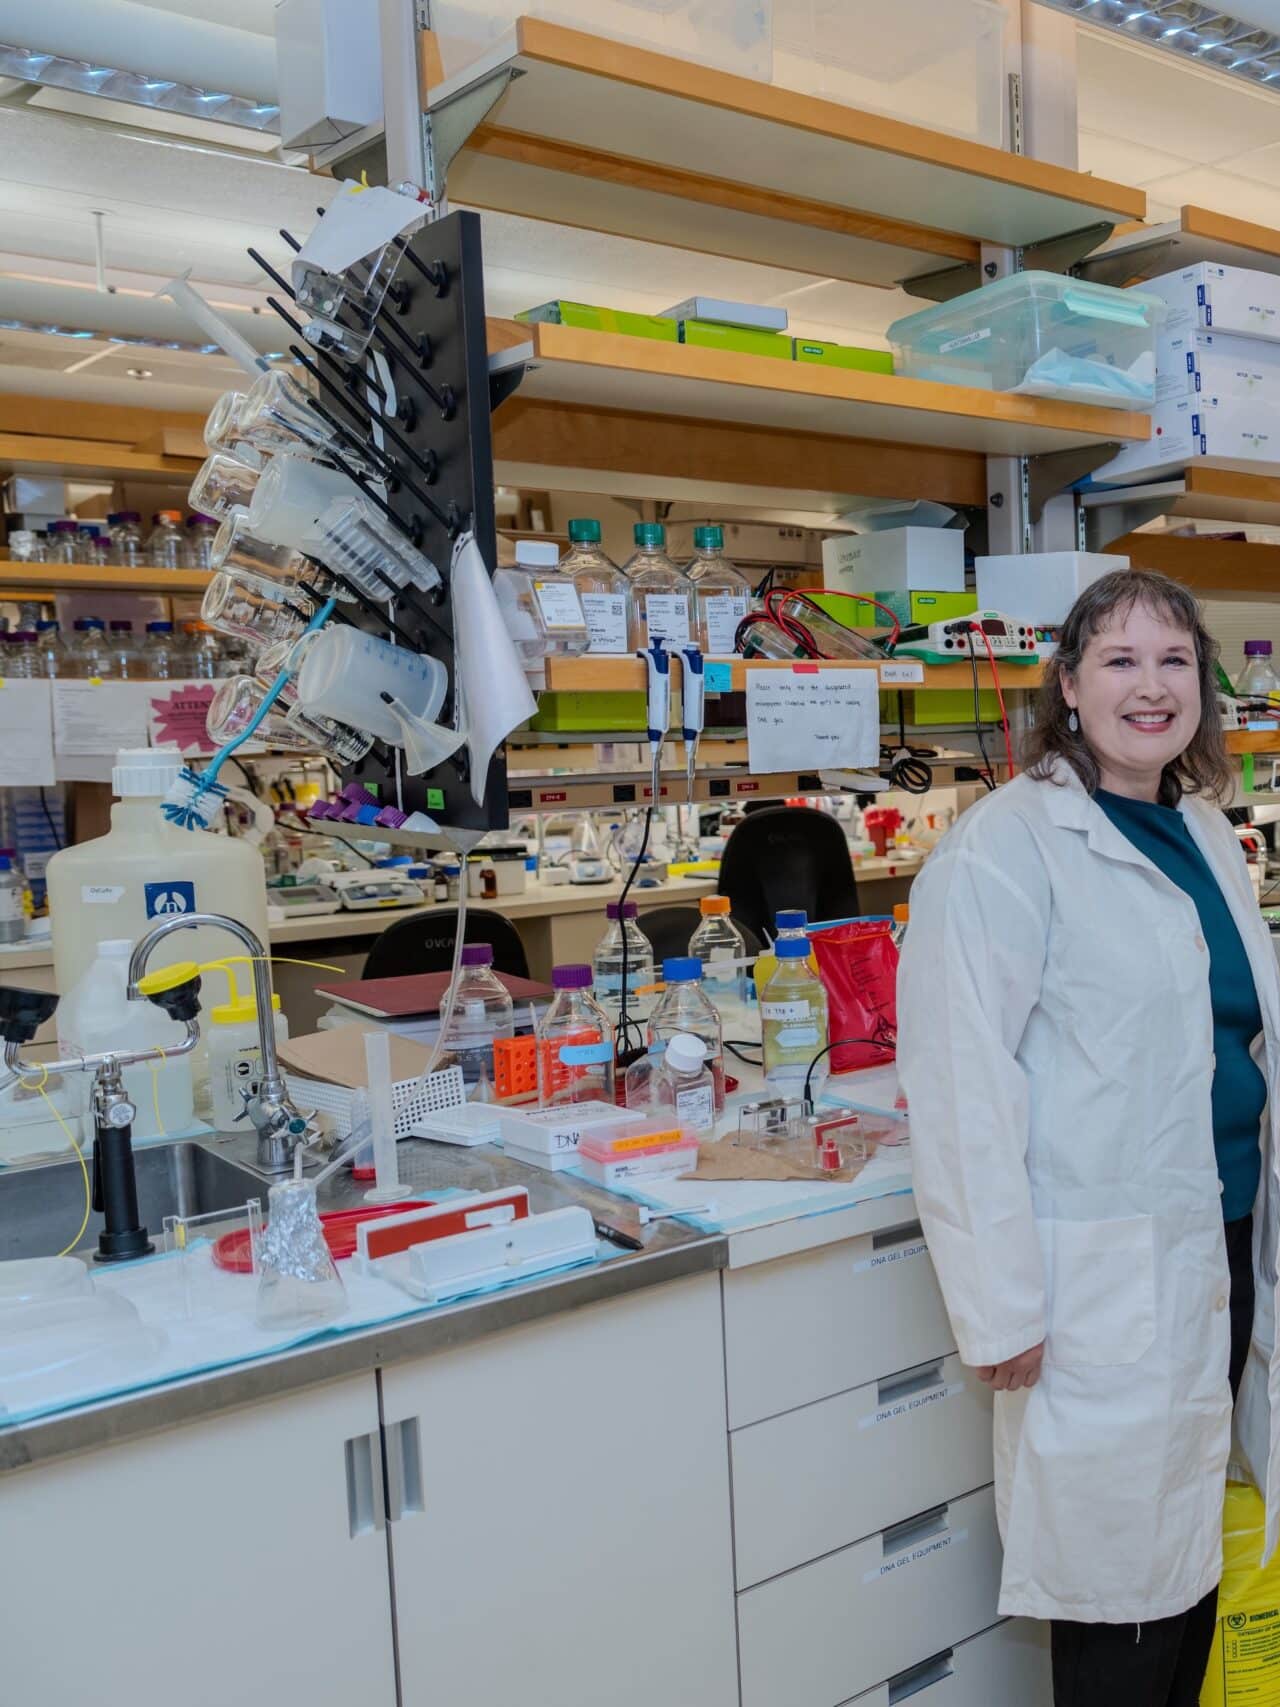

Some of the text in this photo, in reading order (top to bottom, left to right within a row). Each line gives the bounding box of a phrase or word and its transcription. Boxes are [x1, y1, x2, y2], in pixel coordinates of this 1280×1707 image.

[871, 1255, 887, 1267] DNA
[887, 1250, 904, 1263] GEL
[876, 1388, 948, 1422] DNA GEL EQUIPMENT
[880, 1537, 952, 1575] DNA GEL EQUIPMENT
